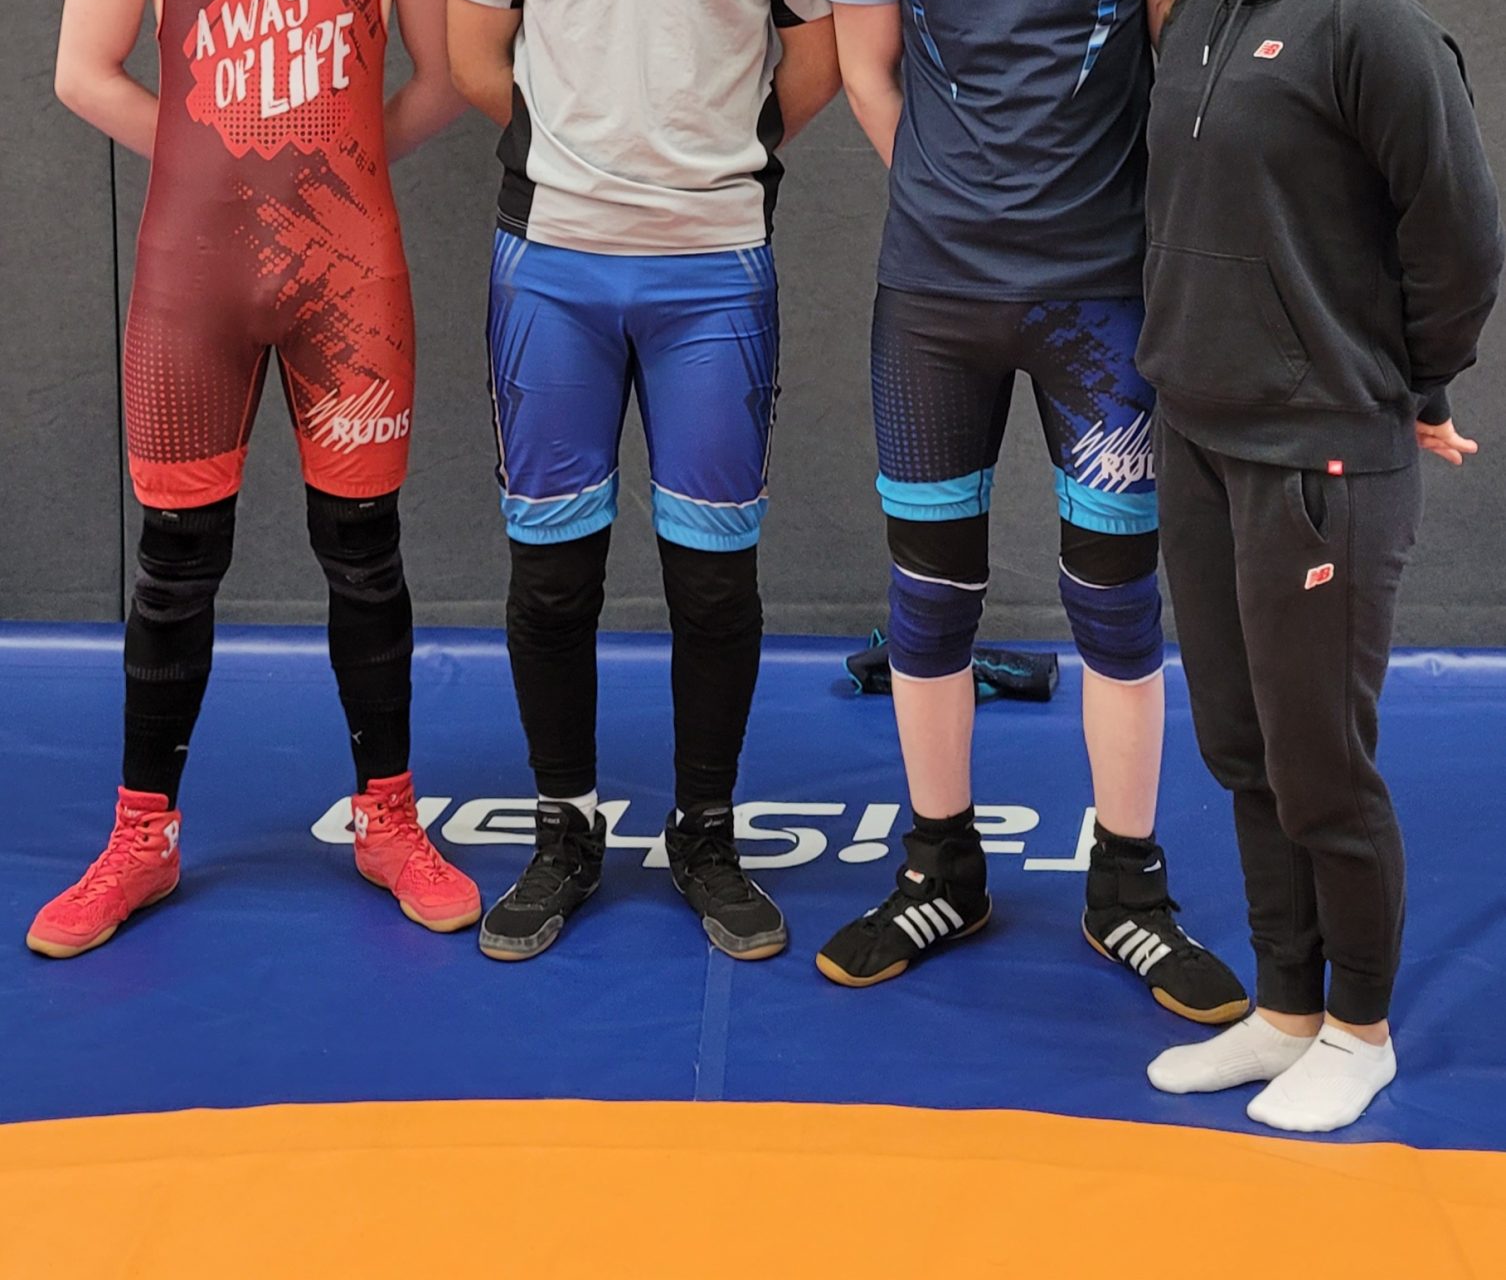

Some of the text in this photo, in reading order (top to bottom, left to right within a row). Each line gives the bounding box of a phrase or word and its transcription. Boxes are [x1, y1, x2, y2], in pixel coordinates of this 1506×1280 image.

[196, 8, 216, 61] A
[215, 48, 256, 109] OF
[331, 408, 411, 445] RUDIS
